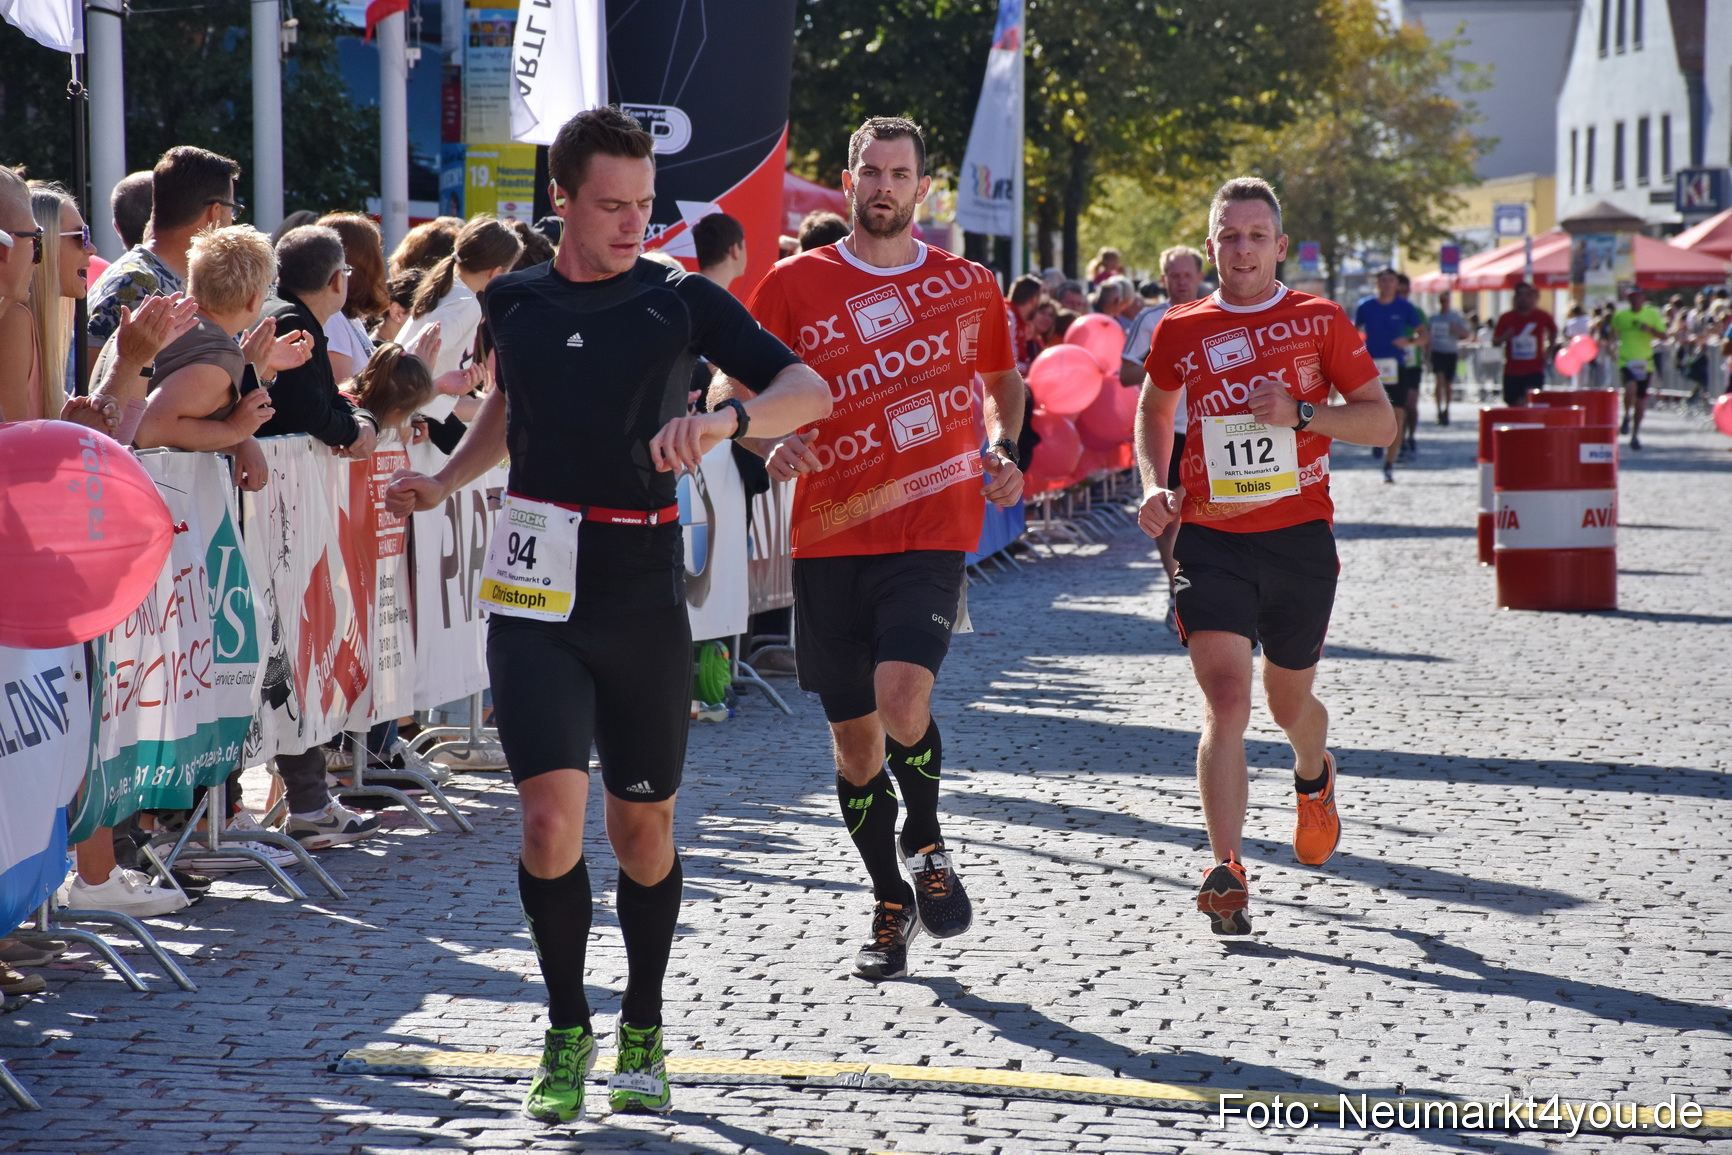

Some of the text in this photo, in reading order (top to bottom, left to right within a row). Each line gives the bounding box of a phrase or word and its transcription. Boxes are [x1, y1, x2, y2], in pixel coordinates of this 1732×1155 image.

[469, 165, 495, 188] 19.
[850, 288, 896, 311] raumbox
[920, 295, 972, 320] schenken
[1205, 331, 1245, 348] raumbox
[1262, 341, 1311, 358] schenken
[856, 381, 902, 410] wohnen
[911, 362, 951, 385] outdoor
[888, 395, 931, 418] raumbox
[1224, 437, 1275, 467] 112
[843, 452, 885, 478] outdoor
[1244, 467, 1271, 475] Neumarkt
[65, 433, 105, 541] RÖDL
[810, 478, 900, 531] Team
[903, 460, 965, 495] raumbox
[1235, 481, 1271, 493] Tobias
[509, 508, 547, 528] BOCK
[507, 532, 537, 570] 94
[508, 572, 540, 584] Neumarkt
[492, 585, 546, 608] Christoph
